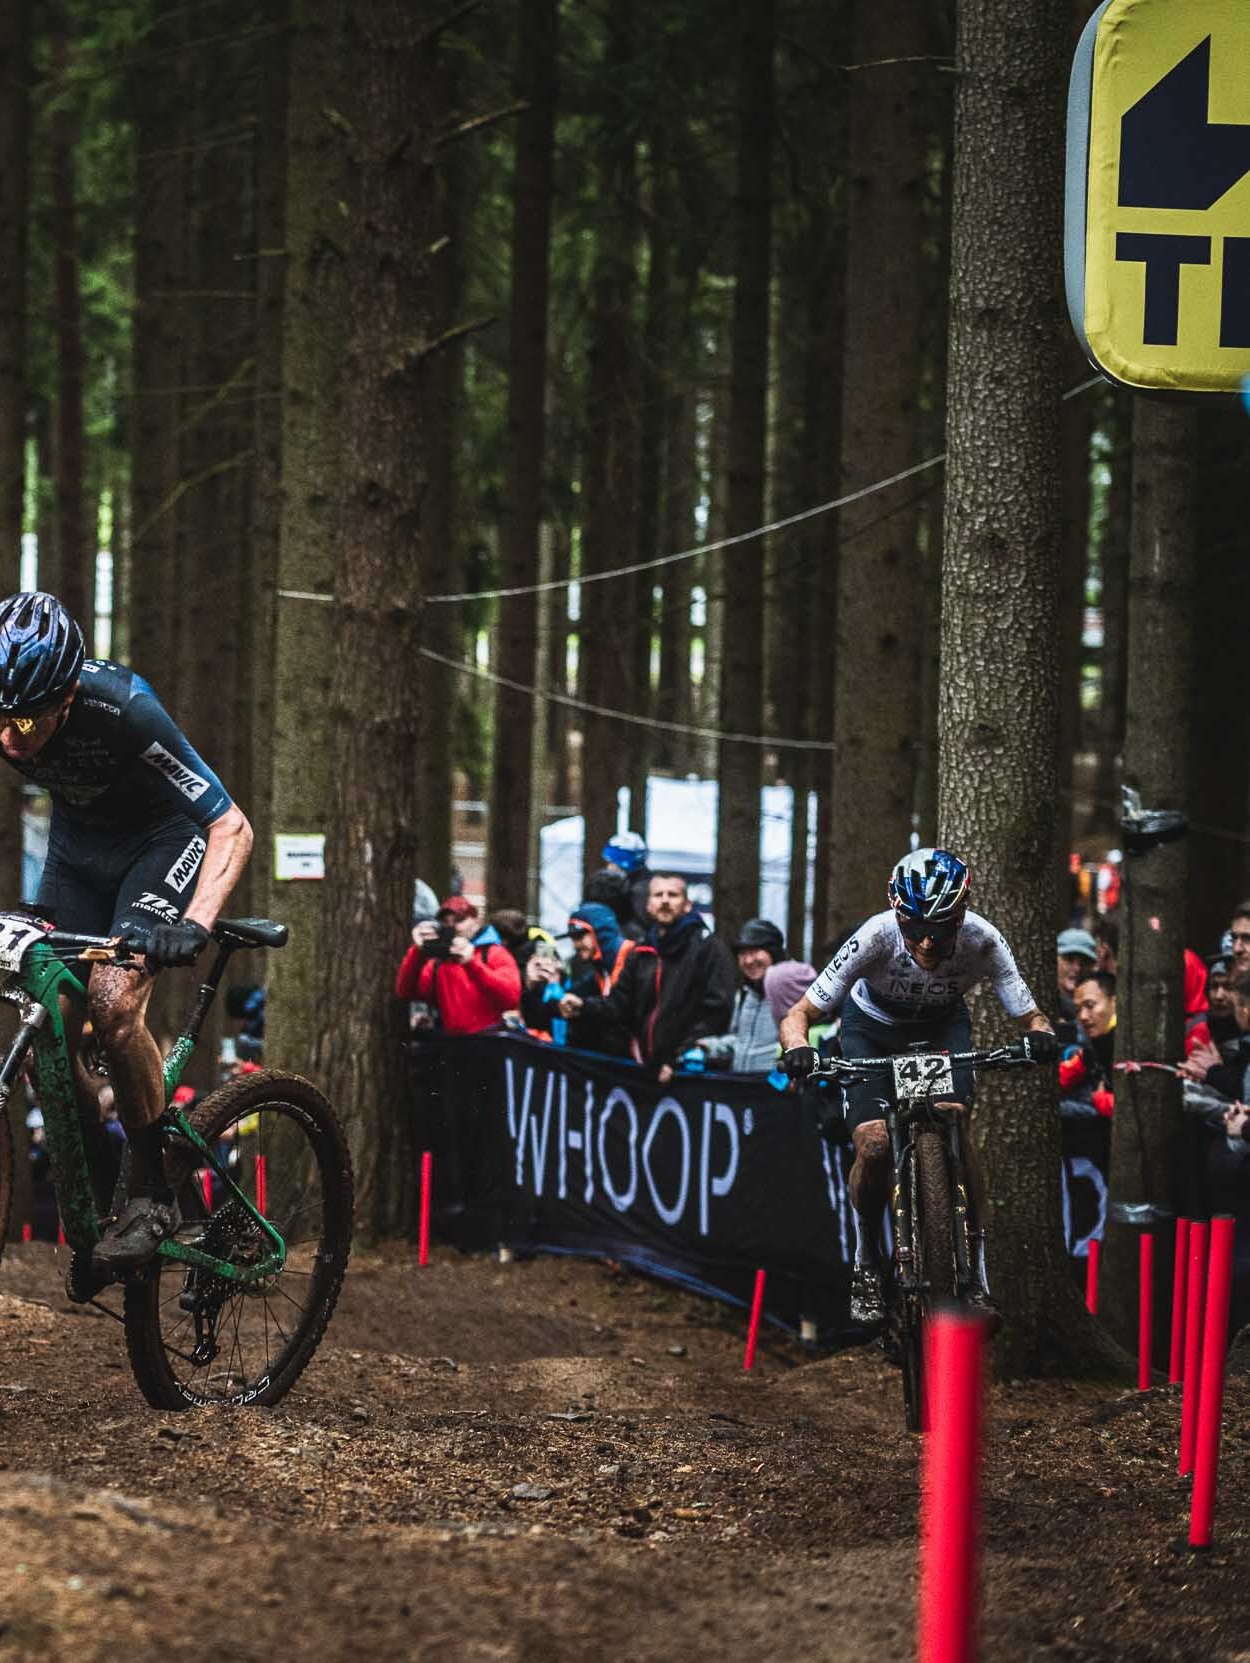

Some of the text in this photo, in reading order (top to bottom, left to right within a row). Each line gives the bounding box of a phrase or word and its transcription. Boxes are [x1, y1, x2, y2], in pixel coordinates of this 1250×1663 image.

[147, 752, 205, 793] MAVIC
[171, 840, 204, 888] MAVIC
[889, 980, 959, 995] INEOS
[899, 1058, 945, 1081] 42
